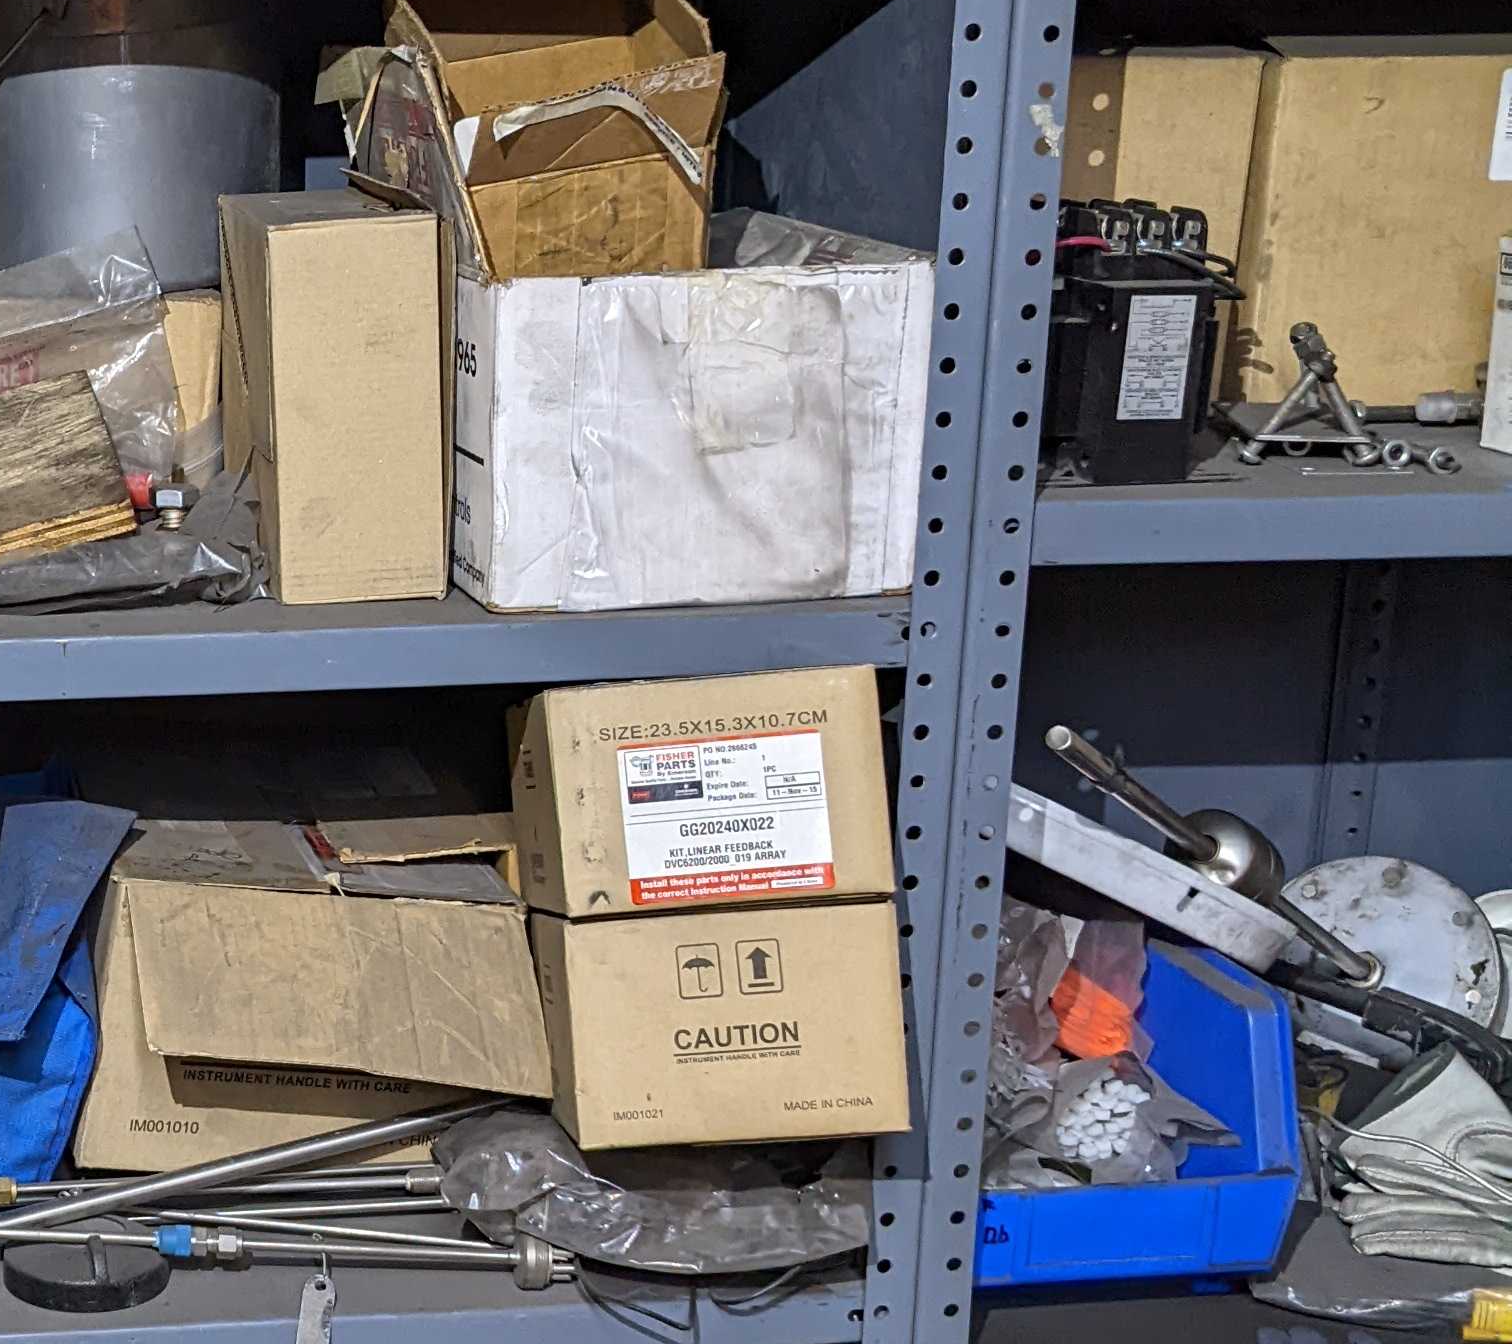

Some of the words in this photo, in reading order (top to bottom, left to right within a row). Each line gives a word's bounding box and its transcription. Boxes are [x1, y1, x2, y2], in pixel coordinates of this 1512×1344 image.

[599, 709, 828, 742] SIZE:23.5X15.3X10.7CM
[656, 751, 695, 762] FISHER
[656, 760, 696, 770] PARTS
[763, 765, 777, 773] 1PC
[706, 782, 729, 791] Expire
[708, 792, 738, 802] Package
[680, 816, 775, 838] GG20240X022
[725, 840, 773, 852] FEEDBACK
[755, 850, 786, 861] ARRAY
[640, 879, 667, 889] Install
[670, 877, 694, 887] these
[696, 876, 719, 886] parts
[721, 874, 739, 884] only
[741, 872, 750, 880] in
[752, 868, 803, 880] accordance
[804, 867, 824, 875] with
[641, 891, 655, 899] the
[657, 889, 689, 898] correct
[691, 885, 737, 896] Instruction
[739, 882, 769, 891] Manual
[674, 1020, 800, 1050] CAUTION
[676, 1055, 724, 1064] INSTRUMENT
[759, 1051, 778, 1059] WITH
[780, 1050, 800, 1058] CARE
[183, 1069, 271, 1085] INSTRUMENT
[275, 1073, 332, 1089] HANDLE
[336, 1077, 370, 1091] WITH
[373, 1080, 412, 1094] CARE
[613, 1109, 664, 1122] IM001021
[784, 1099, 818, 1112] MADE
[821, 1099, 833, 1109] IN
[836, 1096, 874, 1108] CHINA
[129, 1120, 199, 1135] IM001010
